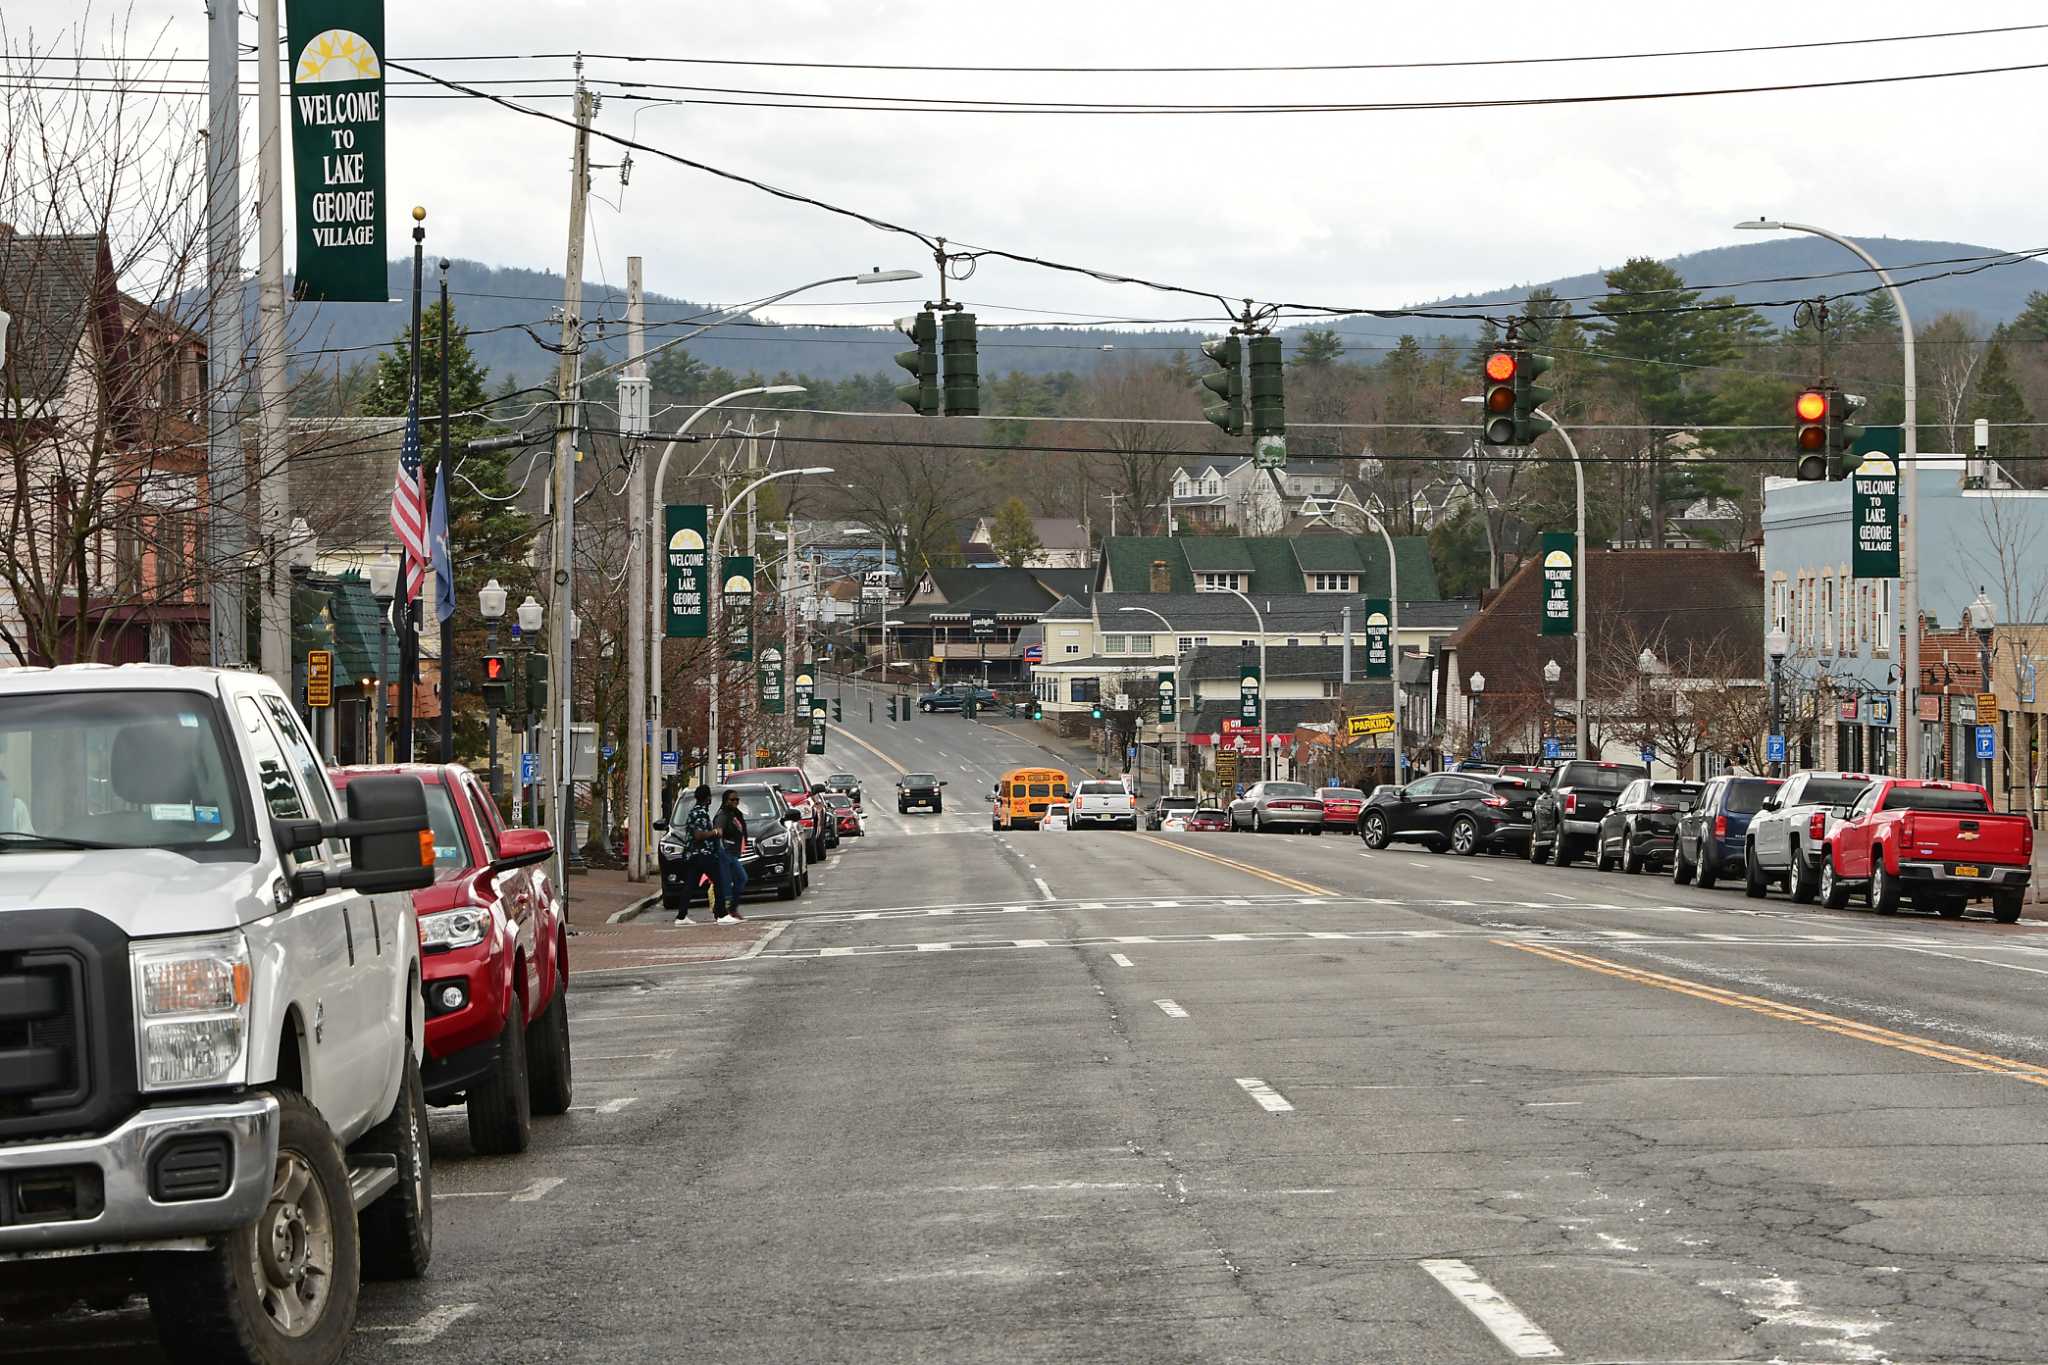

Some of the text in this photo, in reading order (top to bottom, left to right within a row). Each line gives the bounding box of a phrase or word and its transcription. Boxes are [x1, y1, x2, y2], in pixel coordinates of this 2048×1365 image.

[298, 90, 380, 126] WELCOME
[331, 129, 355, 149] TO
[323, 152, 365, 185] LAKE
[312, 189, 375, 224] GEORGE
[312, 226, 374, 247] VILLAGE
[1856, 480, 1896, 494] WELCOME
[1870, 497, 1881, 507] TO
[1865, 508, 1886, 523] LAKE
[1860, 525, 1892, 540] GEORGE
[1859, 541, 1892, 552] VILLAGE
[669, 554, 704, 566] WELCOME
[682, 568, 692, 576] TO
[1545, 570, 1571, 580] WELCOME
[678, 577, 696, 590] LAKE
[673, 592, 701, 605] GEORGE
[1551, 589, 1566, 598] LAKE
[673, 606, 701, 614] VILLAGE
[1354, 718, 1391, 731] PARKING
[1773, 743, 1780, 752] P
[1982, 740, 1989, 751] P
